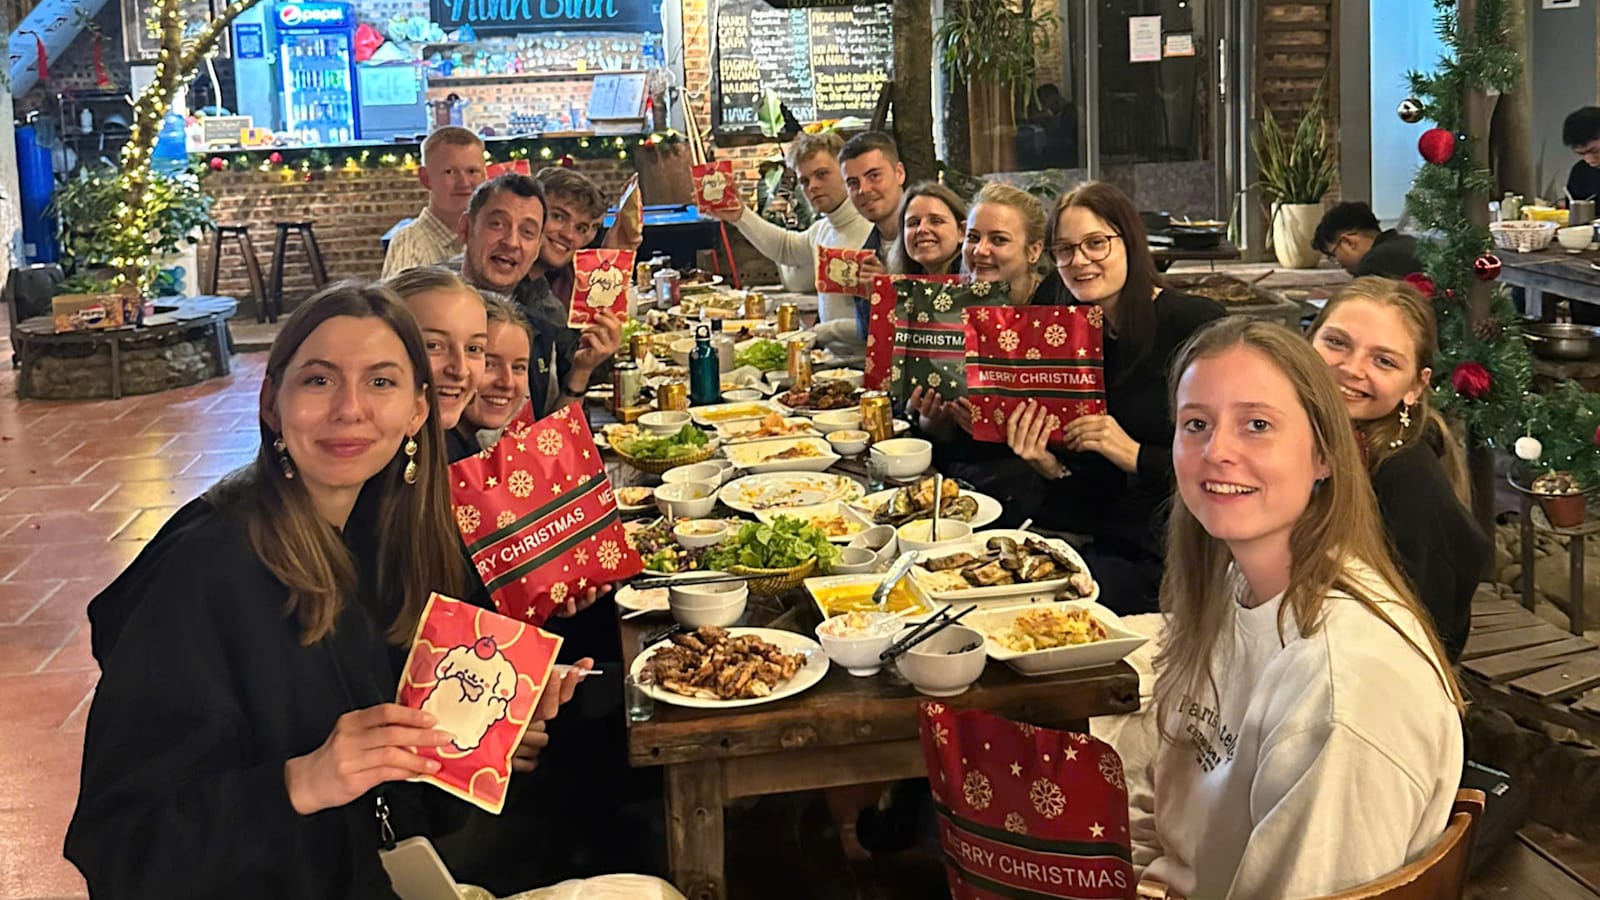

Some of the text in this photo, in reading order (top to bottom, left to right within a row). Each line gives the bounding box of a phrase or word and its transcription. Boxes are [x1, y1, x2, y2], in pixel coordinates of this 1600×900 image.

[303, 7, 344, 22] pepsi
[978, 370, 1097, 385] MERRY CHRISTMAS
[500, 508, 585, 563] CHRISTMAS
[999, 855, 1127, 889] CHRISTMAS
